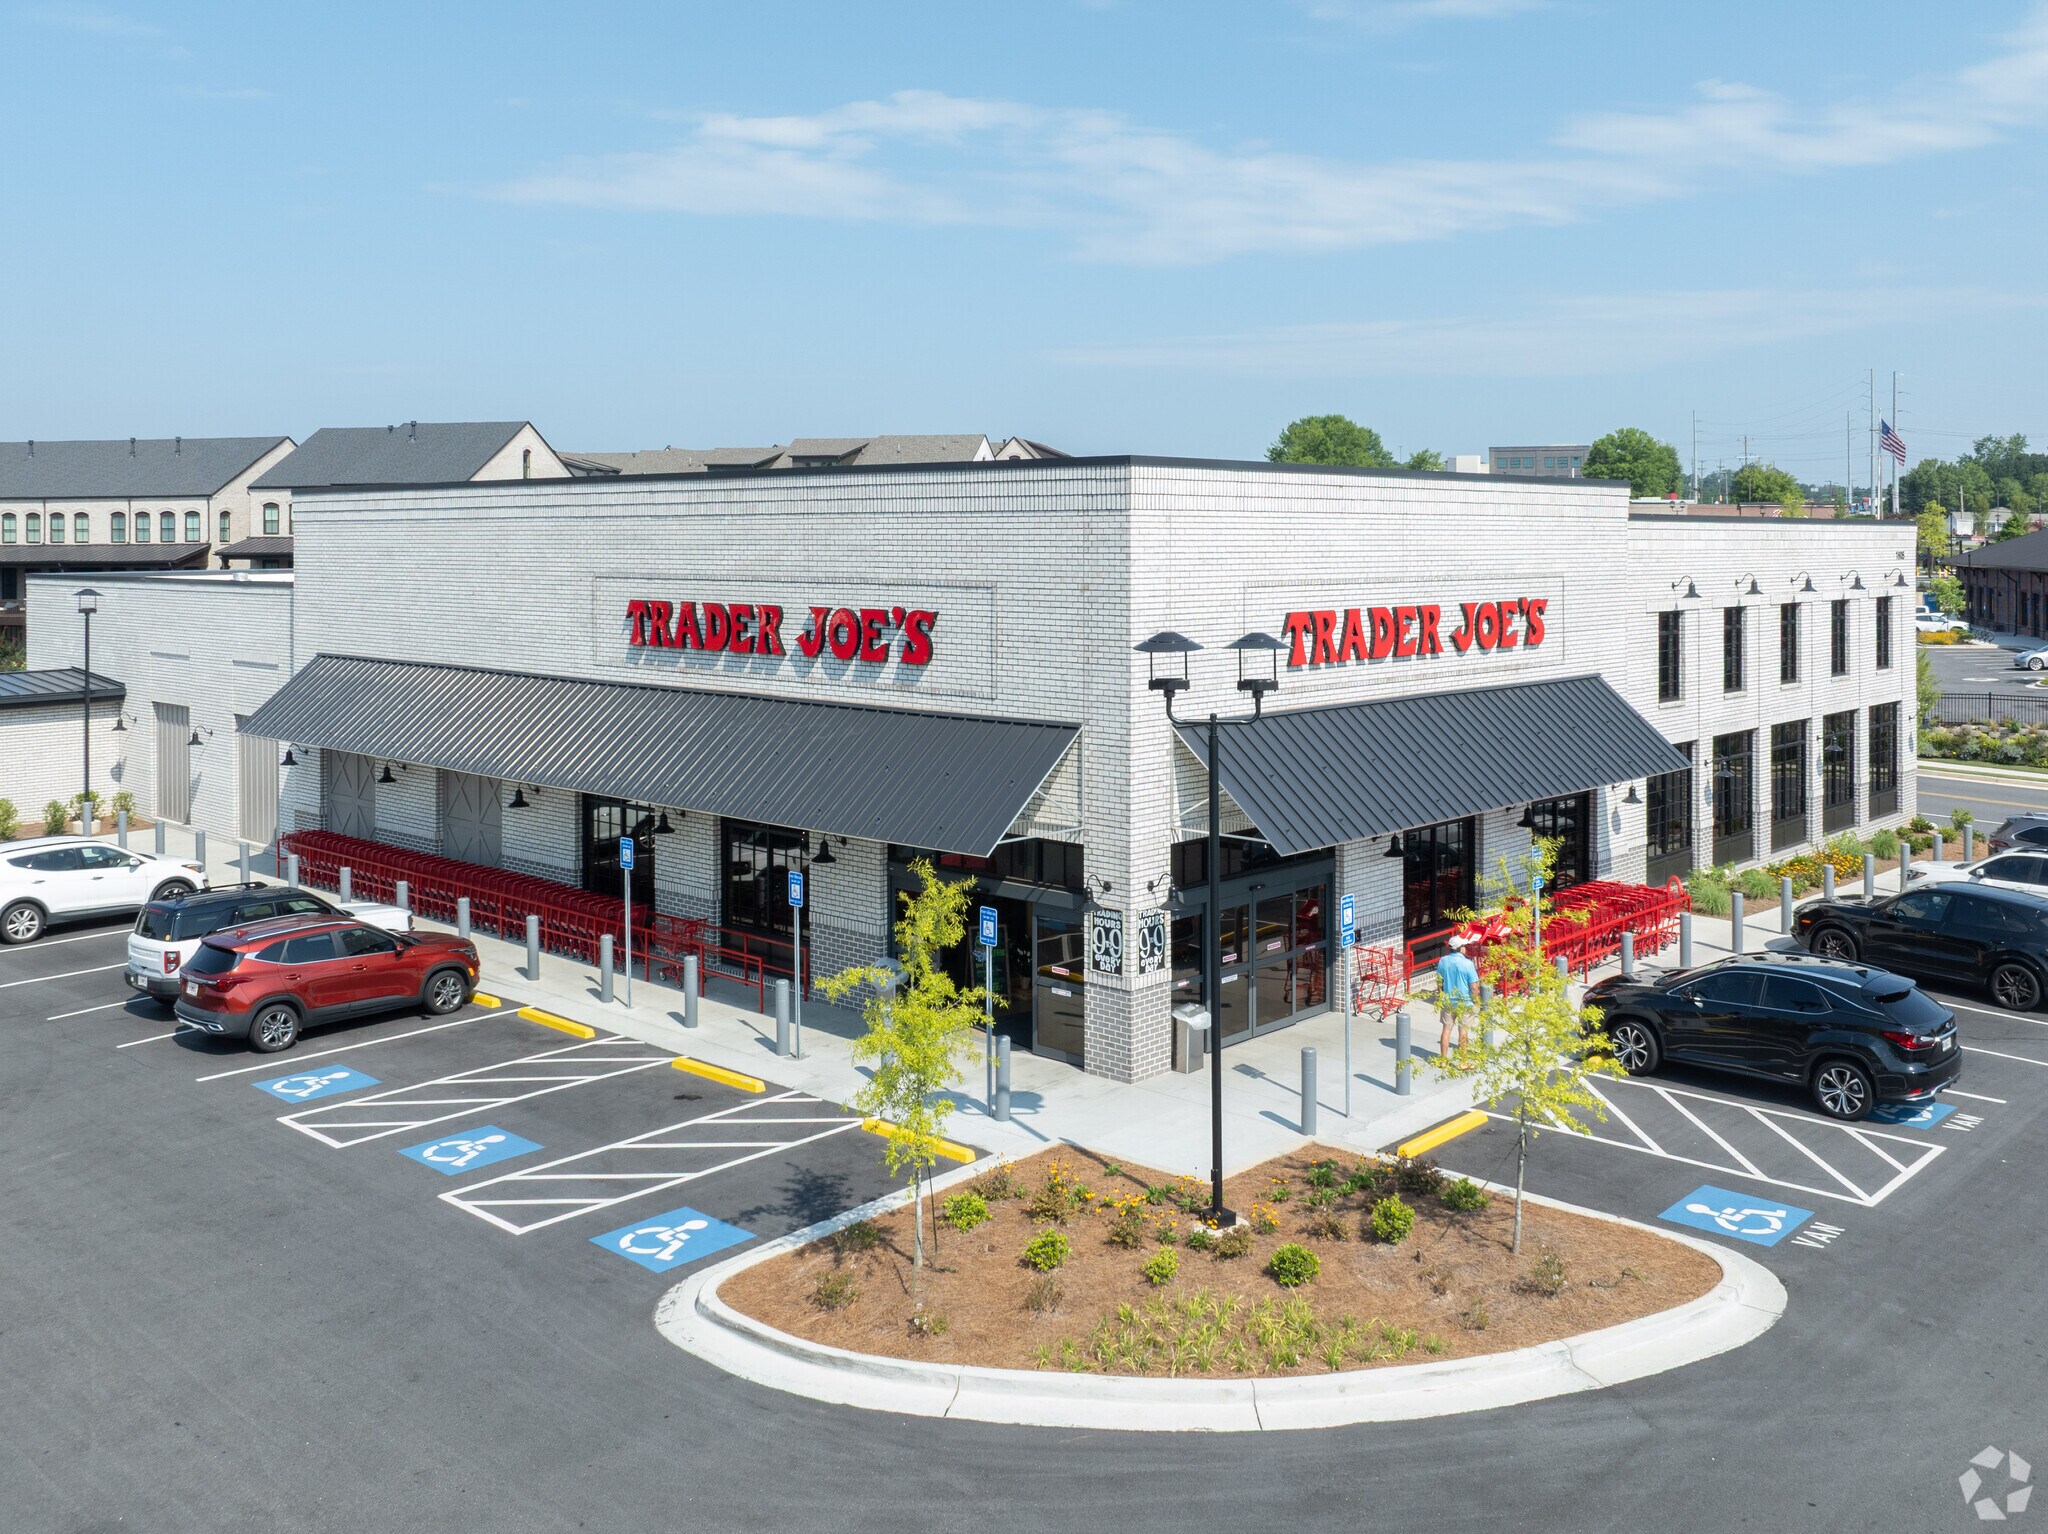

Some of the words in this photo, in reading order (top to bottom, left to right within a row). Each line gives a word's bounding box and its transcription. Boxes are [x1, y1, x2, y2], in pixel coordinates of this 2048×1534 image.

[625, 599, 787, 656] TRADER
[795, 605, 940, 665] JOE'S
[1281, 604, 1444, 666] TRADER
[1449, 596, 1549, 651] JOE'S
[1094, 917, 1121, 929] HOURS
[1138, 914, 1164, 928] HOURS
[1093, 927, 1105, 954] 9
[1109, 929, 1122, 958] 9
[1139, 929, 1150, 958] 9
[1153, 925, 1164, 955] 9
[1942, 1112, 1985, 1132] VAN
[1790, 1221, 1846, 1249] VAN
